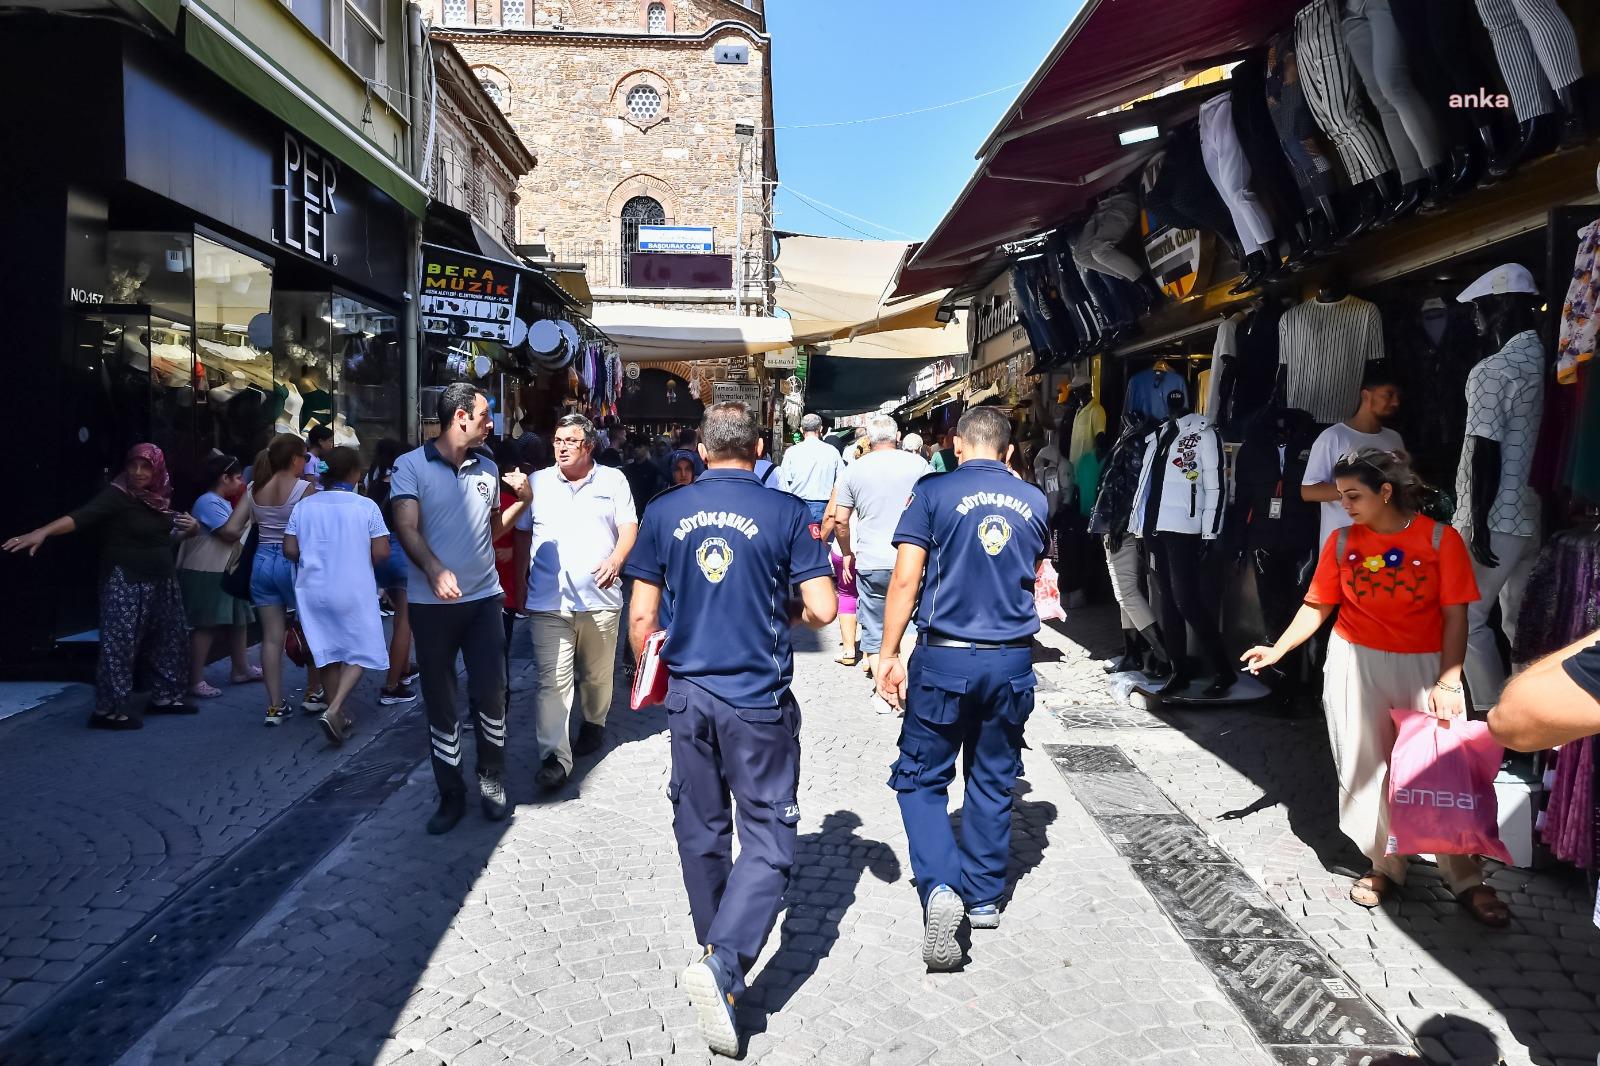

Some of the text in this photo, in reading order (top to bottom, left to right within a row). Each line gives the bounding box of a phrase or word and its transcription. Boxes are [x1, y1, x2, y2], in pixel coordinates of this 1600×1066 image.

[284, 131, 337, 214] PER
[284, 189, 328, 262] LEI
[425, 277, 509, 295] MÜZİK
[427, 263, 495, 281] BERA
[956, 491, 1033, 521] BÜYÜKŞEHİR
[673, 510, 759, 541] BÜYÜKŞEHİR
